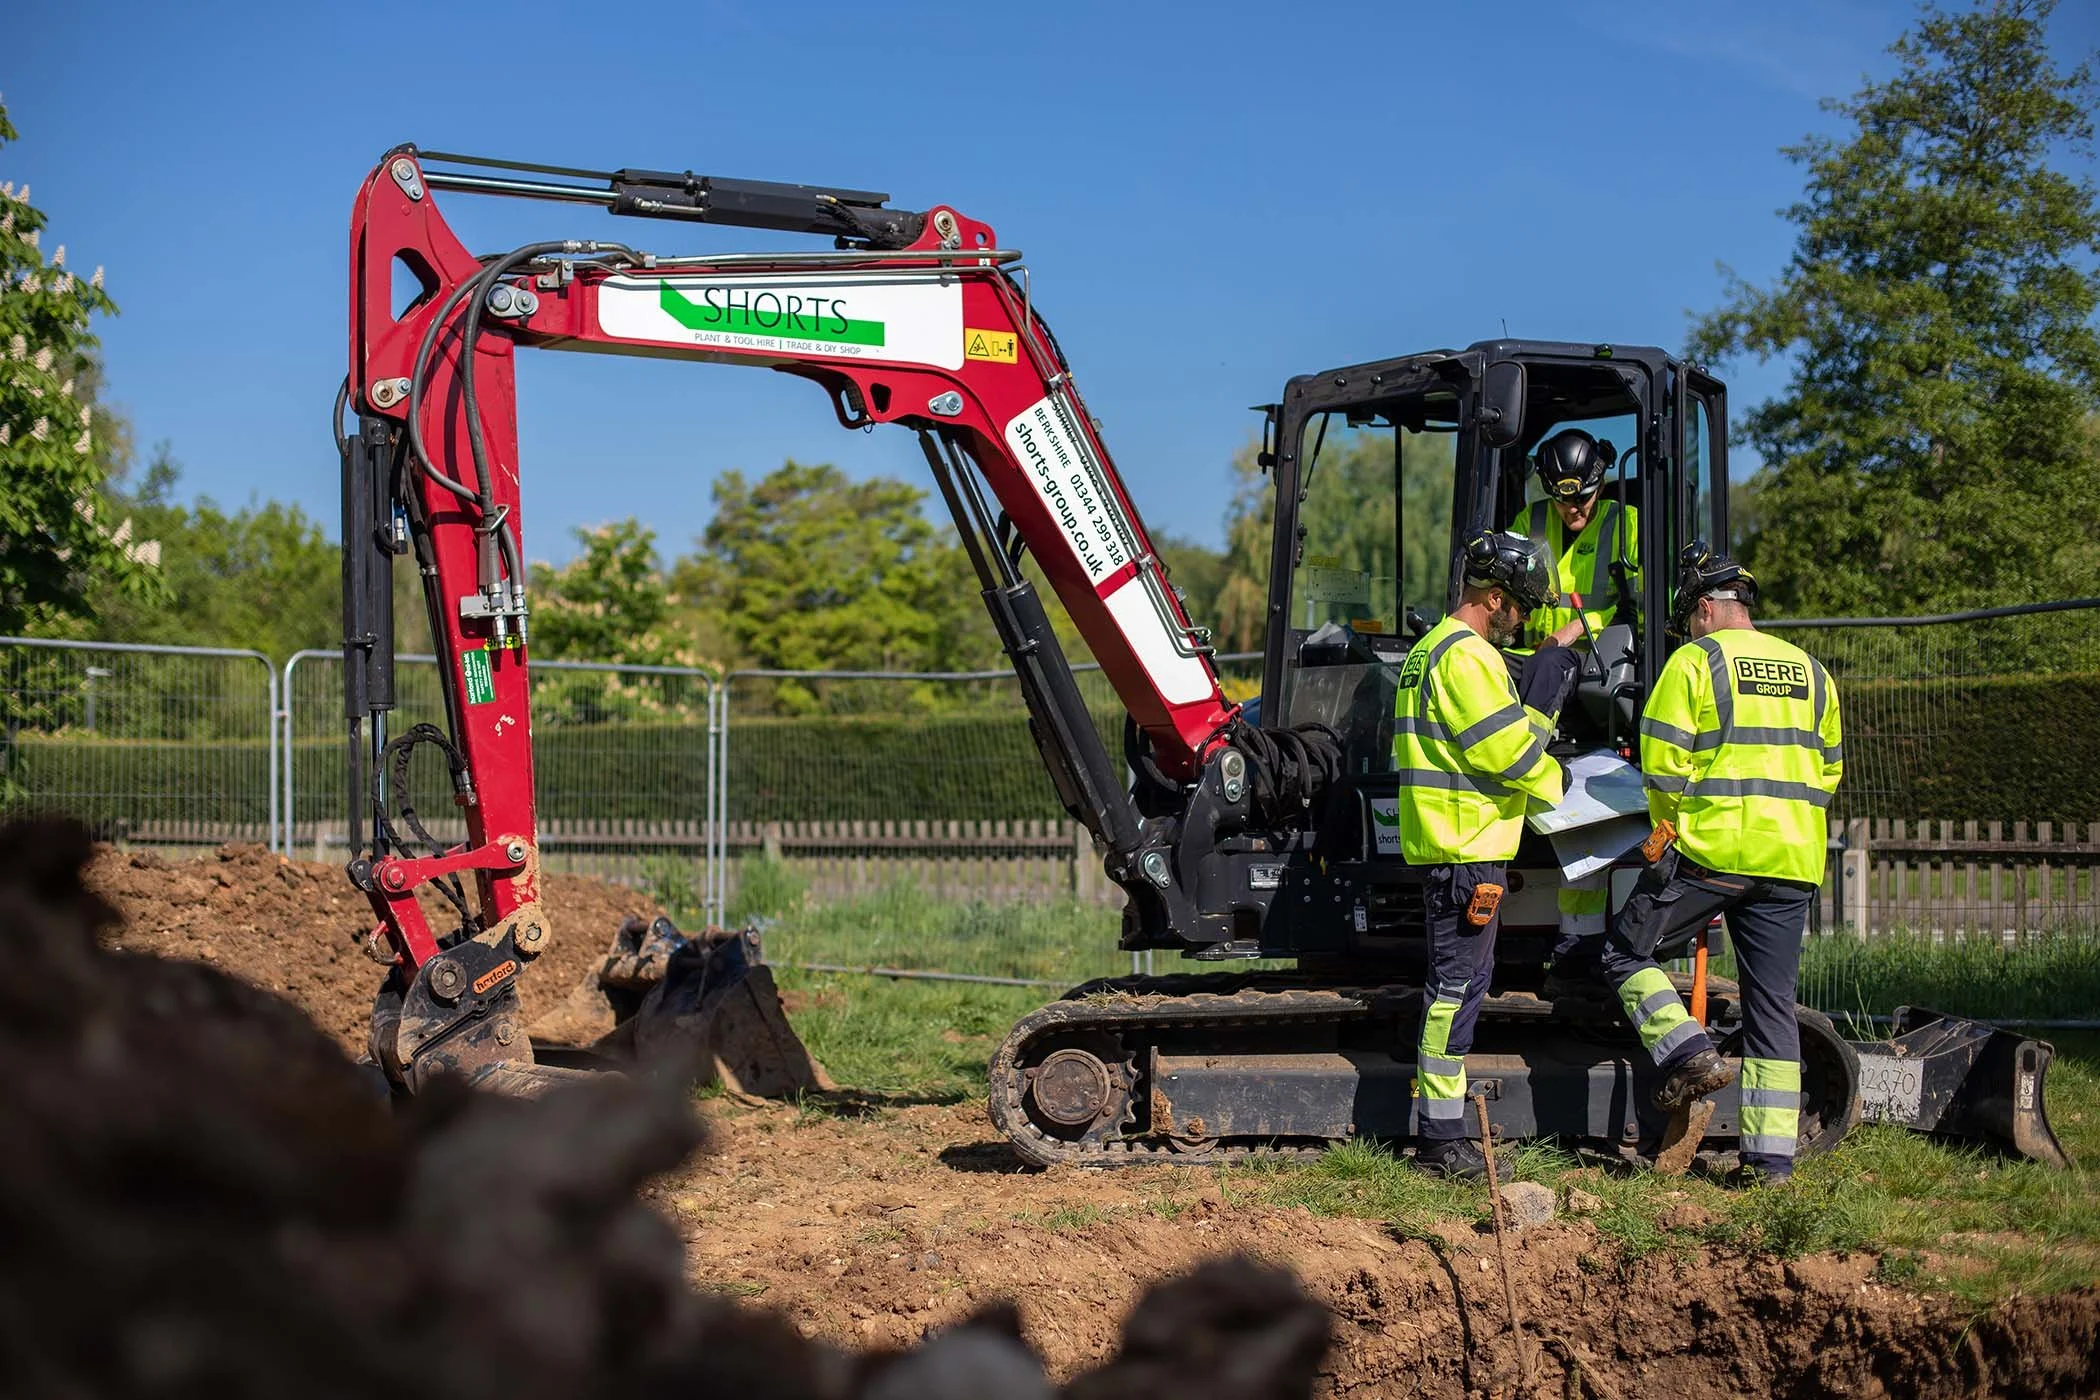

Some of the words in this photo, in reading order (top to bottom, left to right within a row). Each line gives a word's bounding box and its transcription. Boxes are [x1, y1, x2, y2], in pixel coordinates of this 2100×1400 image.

[704, 287, 848, 334] SHORTS
[694, 333, 721, 343] PLANT
[724, 335, 731, 343] &
[734, 335, 755, 346] TOOL
[756, 338, 775, 347] HIRE
[787, 340, 812, 351] TRADE
[815, 343, 822, 351] &
[824, 343, 837, 352] DIY
[840, 345, 861, 355] SHOP
[1015, 423, 1103, 577] shorts-group.co.uk
[1034, 407, 1071, 468] BERKSHIRE
[1070, 474, 1097, 514] 01344
[1092, 516, 1112, 542] 299
[1105, 541, 1124, 566] 318
[1739, 661, 1804, 682] BEERE
[1756, 684, 1792, 695] GROUP
